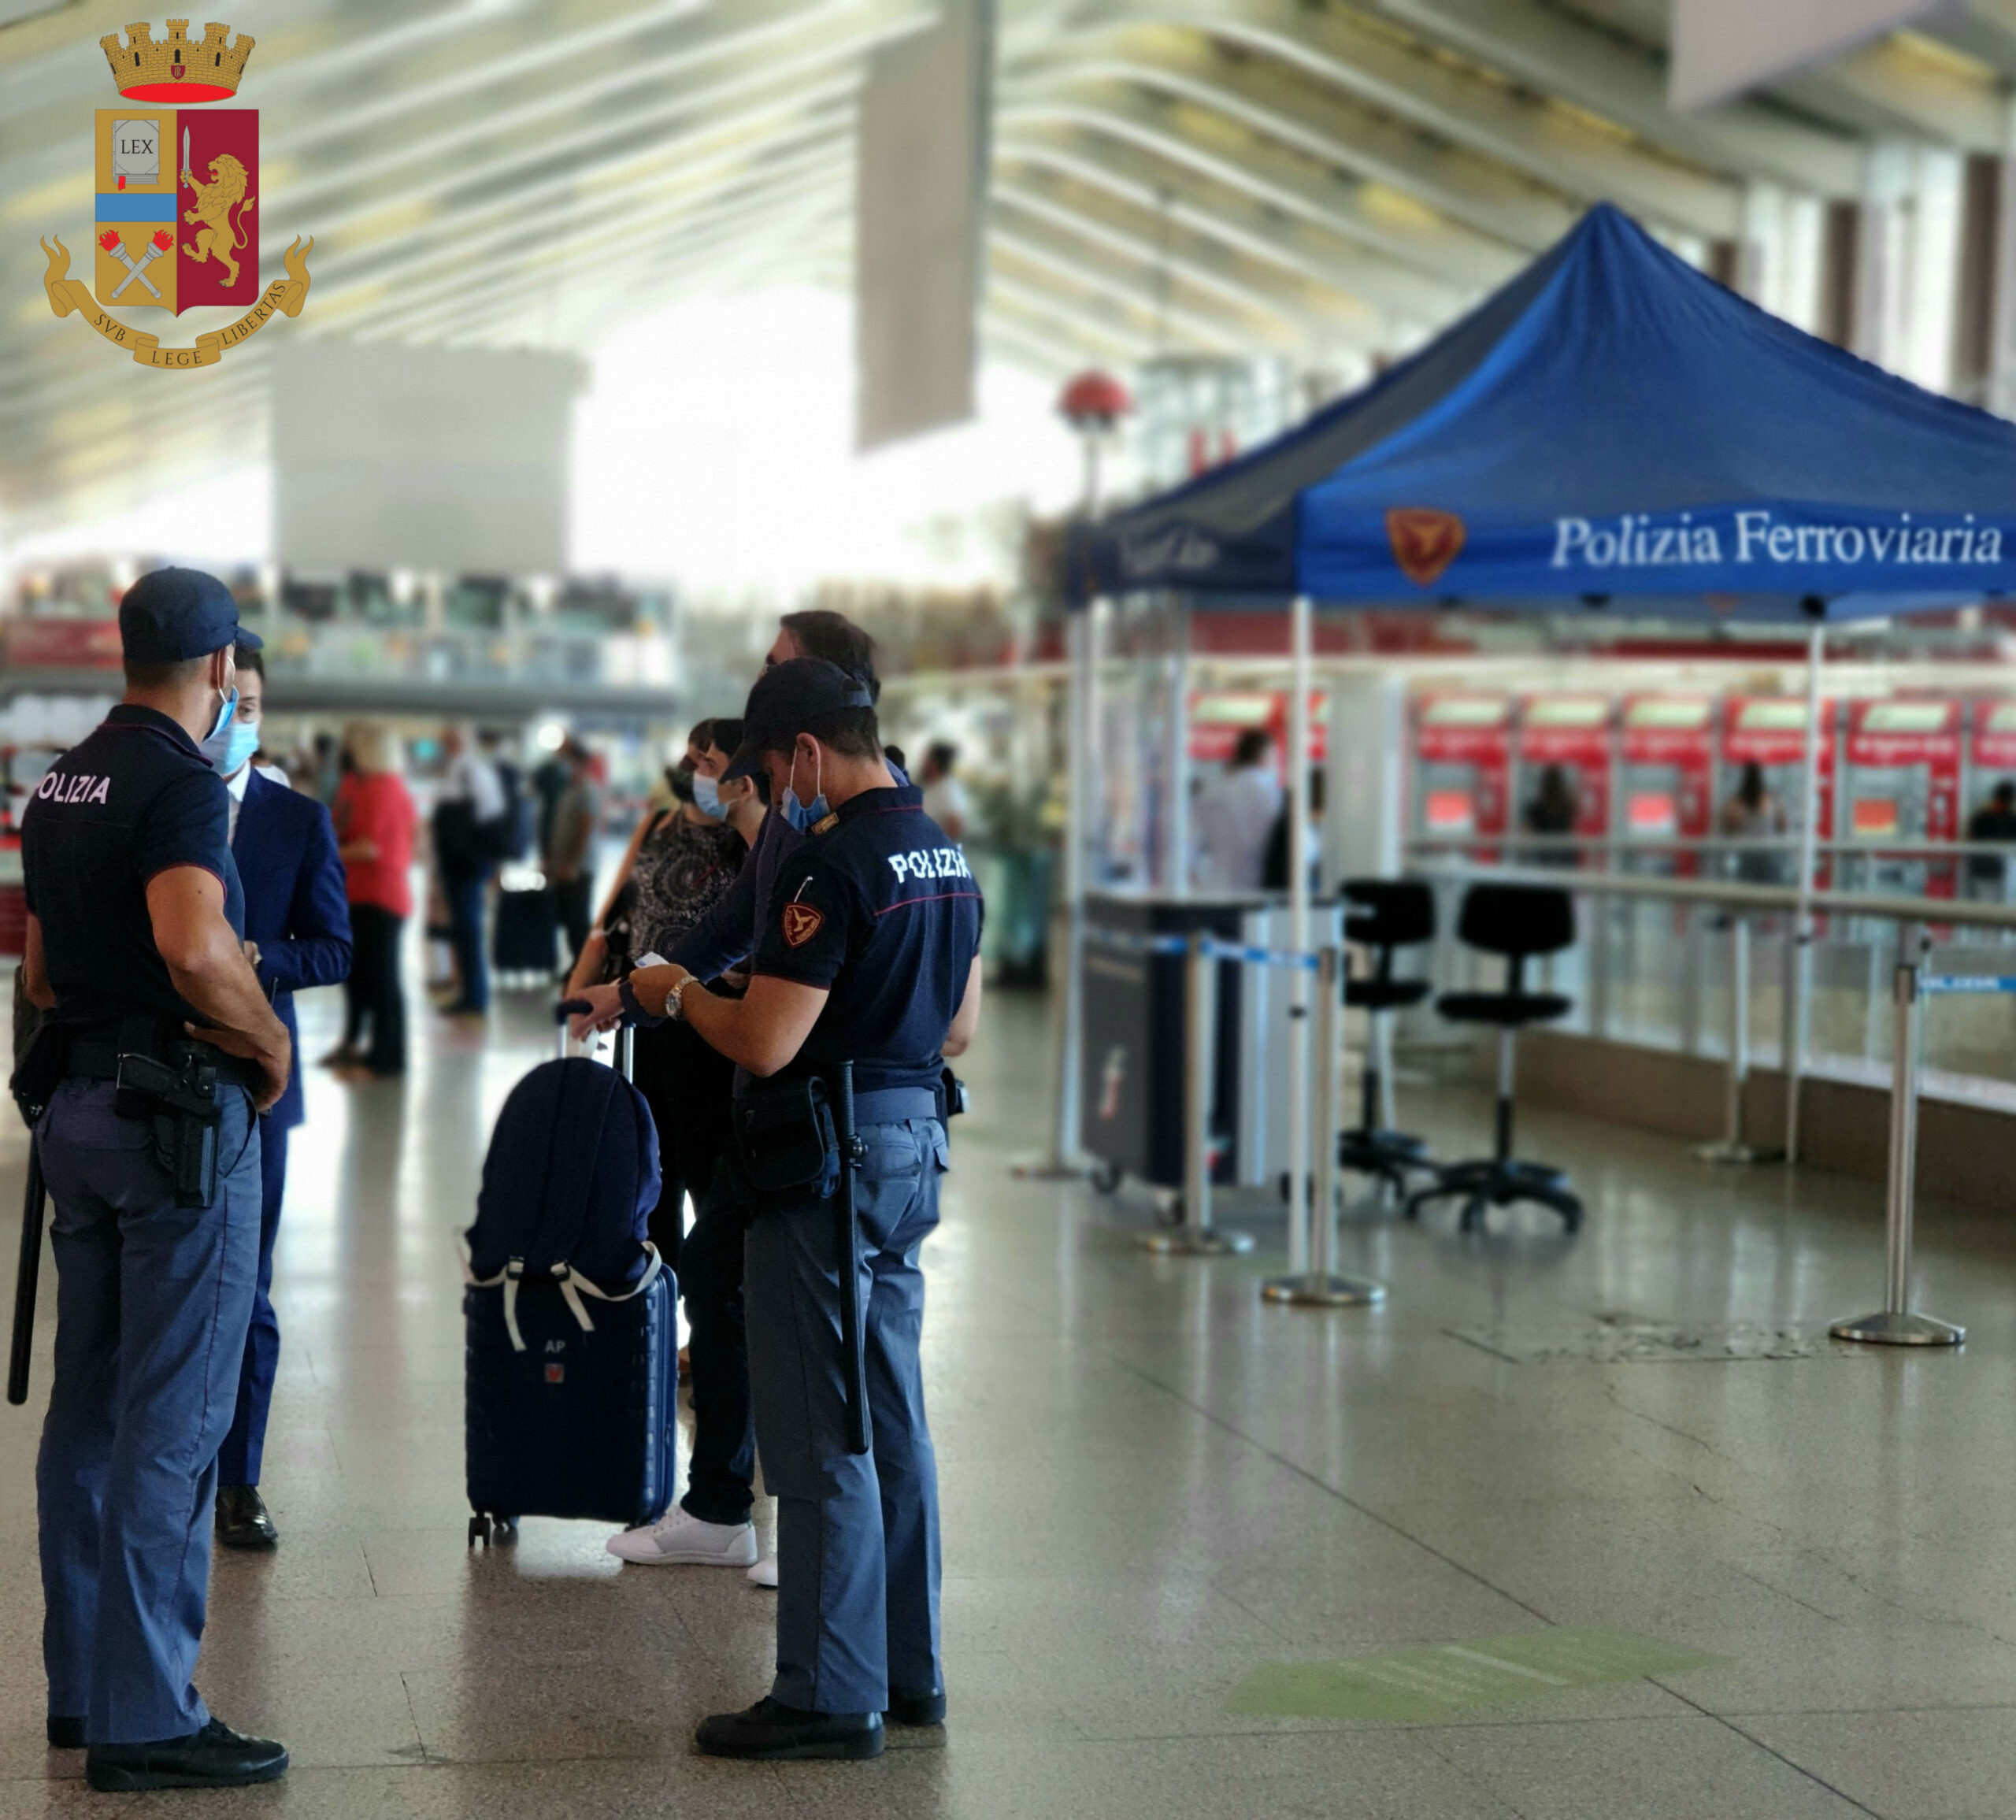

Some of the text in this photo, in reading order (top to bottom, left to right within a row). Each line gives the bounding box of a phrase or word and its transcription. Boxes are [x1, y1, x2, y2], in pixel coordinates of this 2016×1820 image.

[1551, 510, 2003, 569] Polizia Ferroviaria
[36, 772, 111, 805] OLIZIA
